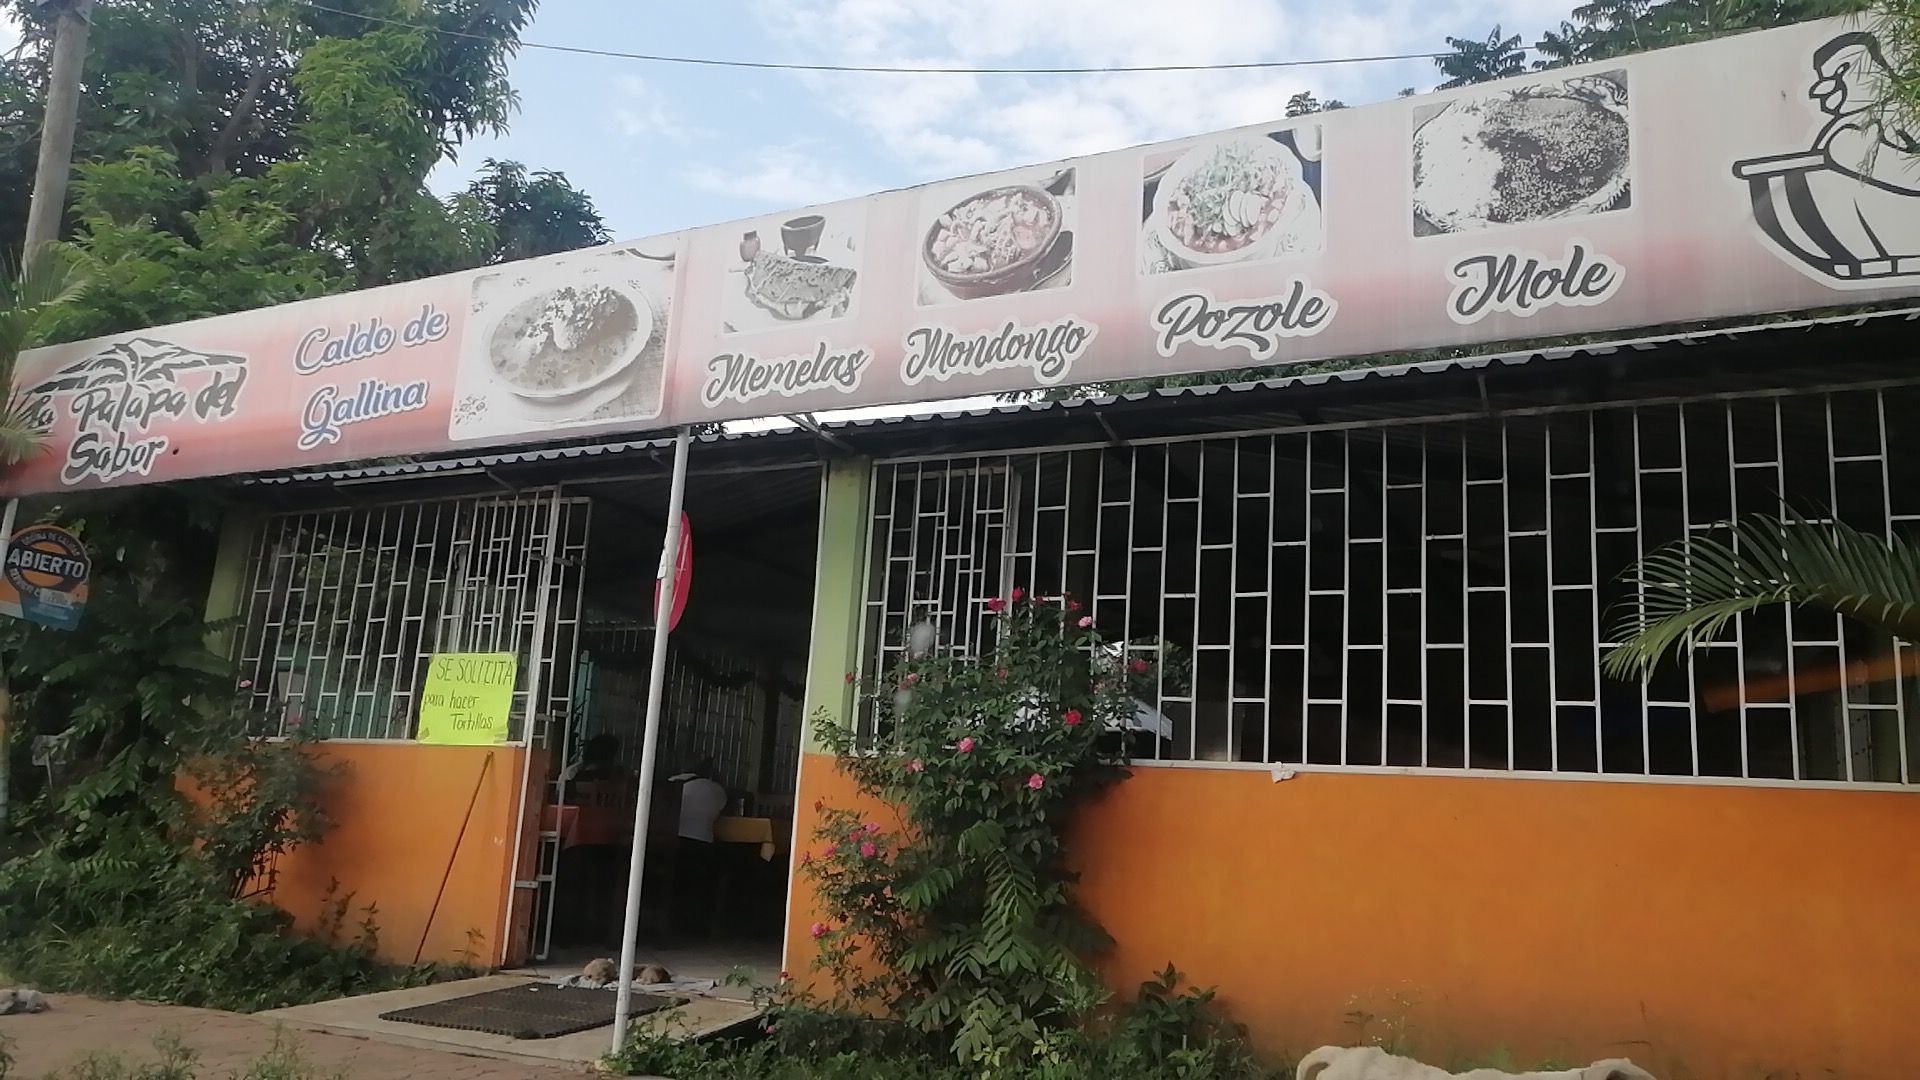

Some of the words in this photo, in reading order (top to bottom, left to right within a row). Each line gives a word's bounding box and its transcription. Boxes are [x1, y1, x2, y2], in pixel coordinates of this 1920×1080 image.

[1454, 245, 1616, 316] Mole
[294, 317, 395, 373] Caldo
[402, 303, 449, 345] de
[1157, 280, 1331, 352] Pozole
[706, 341, 869, 402] Memelas
[905, 319, 1092, 379] Mondongo
[72, 382, 187, 432] Palapa
[195, 365, 248, 419] del
[299, 379, 428, 447] Gallina
[64, 431, 166, 480] Sabor
[7, 548, 85, 578] ABIERTO
[436, 657, 454, 682] SE
[421, 693, 445, 713] para
[449, 689, 480, 709] hacer
[450, 712, 494, 731] Tortillas
